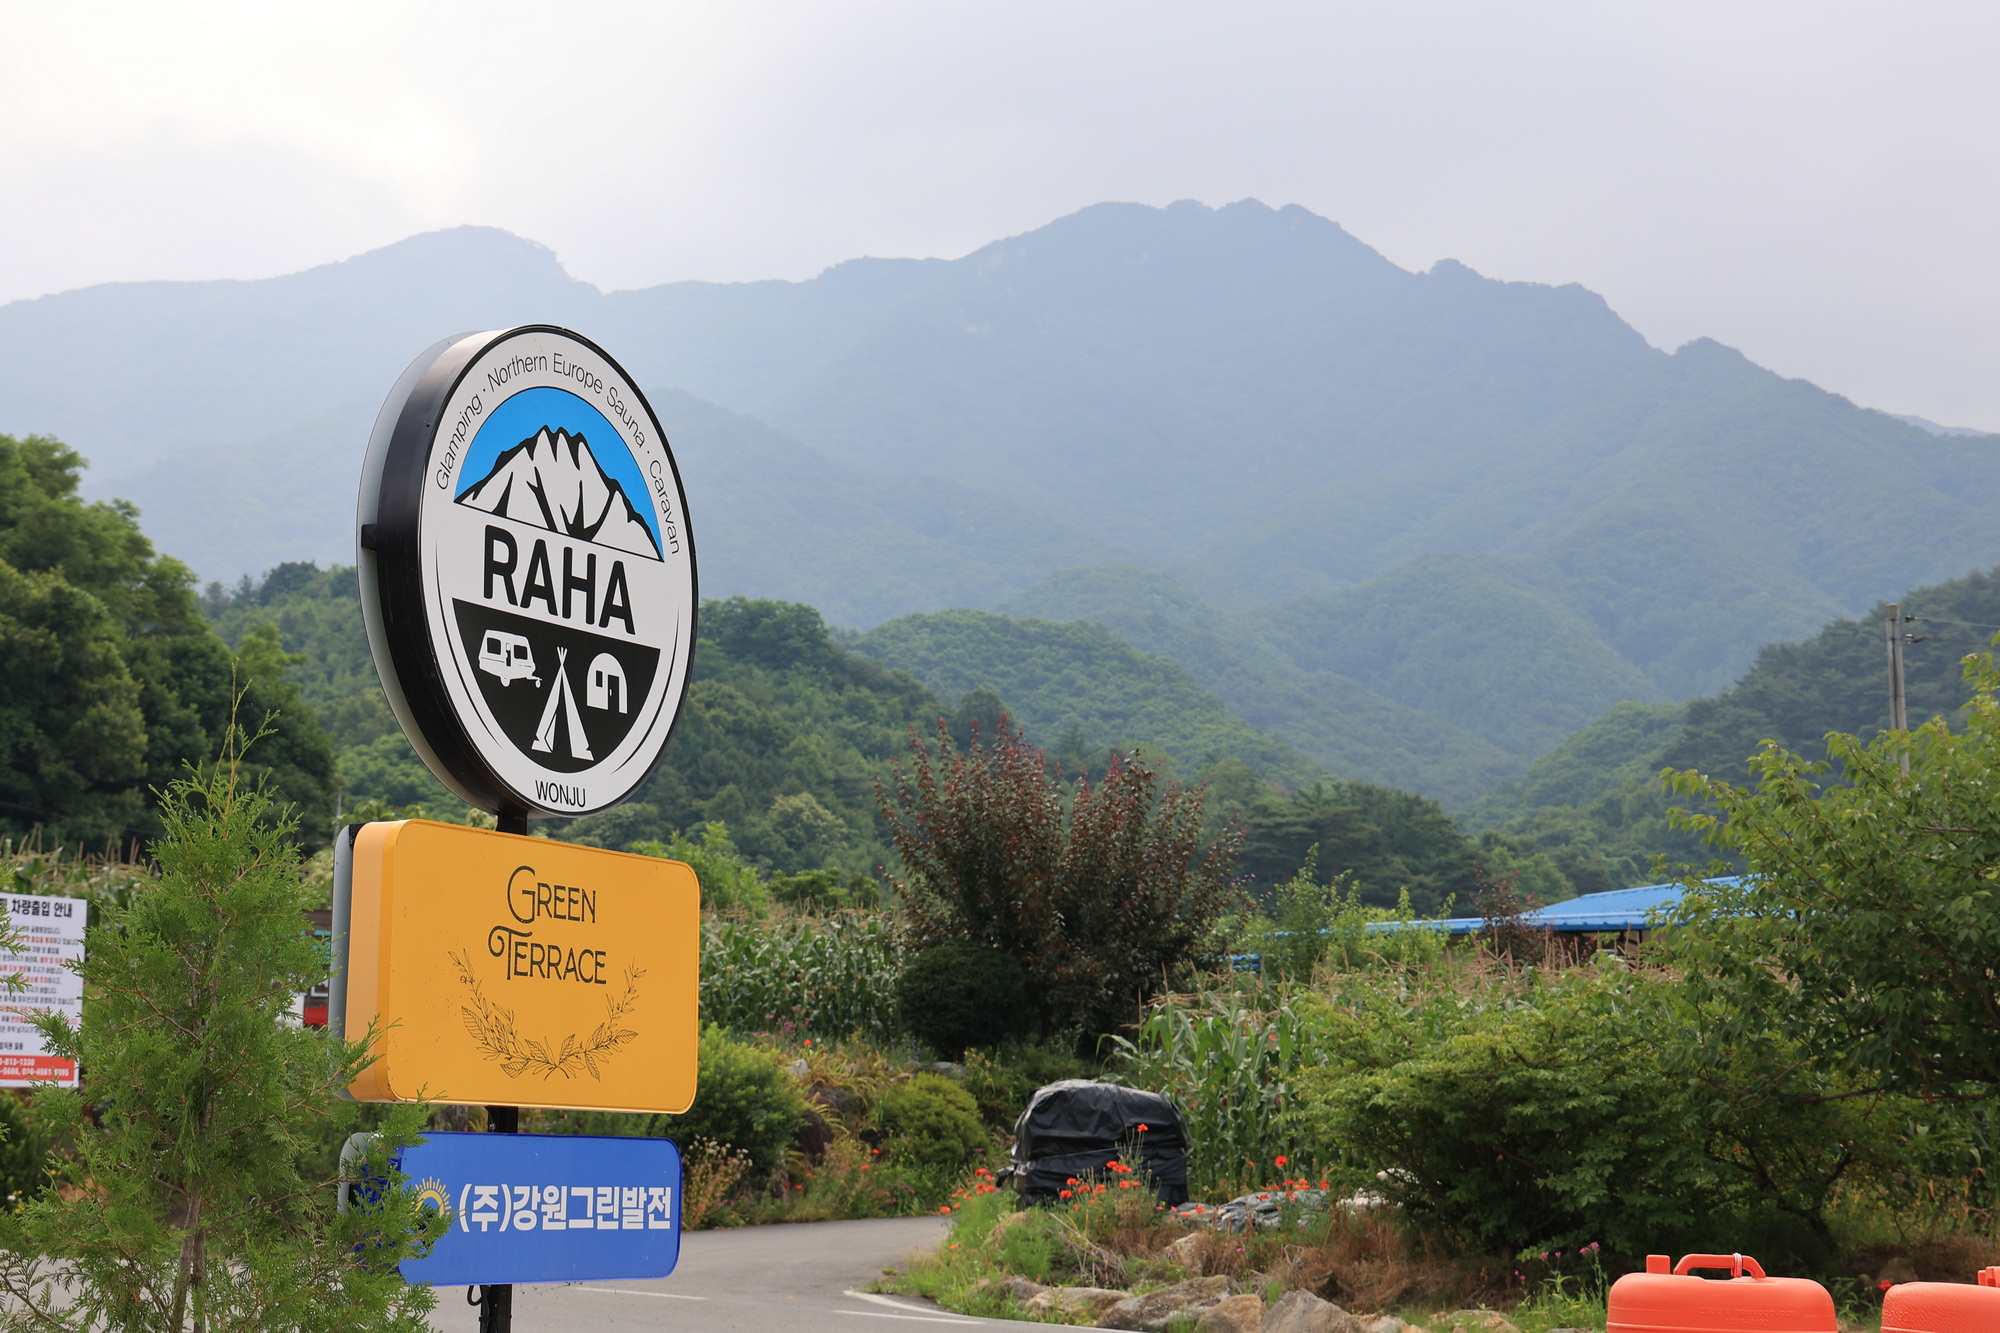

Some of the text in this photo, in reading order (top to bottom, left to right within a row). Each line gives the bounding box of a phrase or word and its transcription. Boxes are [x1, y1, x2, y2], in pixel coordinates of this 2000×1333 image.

[436, 352, 680, 555] Glamping Northern Europe Sauna Caravan
[483, 524, 636, 636] RAHA
[534, 779, 586, 809] WONJU
[11, 898, 50, 917] 차량출입
[54, 902, 72, 918] 안내
[507, 865, 597, 924] GREEN
[488, 925, 607, 985] TERRACE
[459, 1183, 671, 1233] (주)강원그린발전
